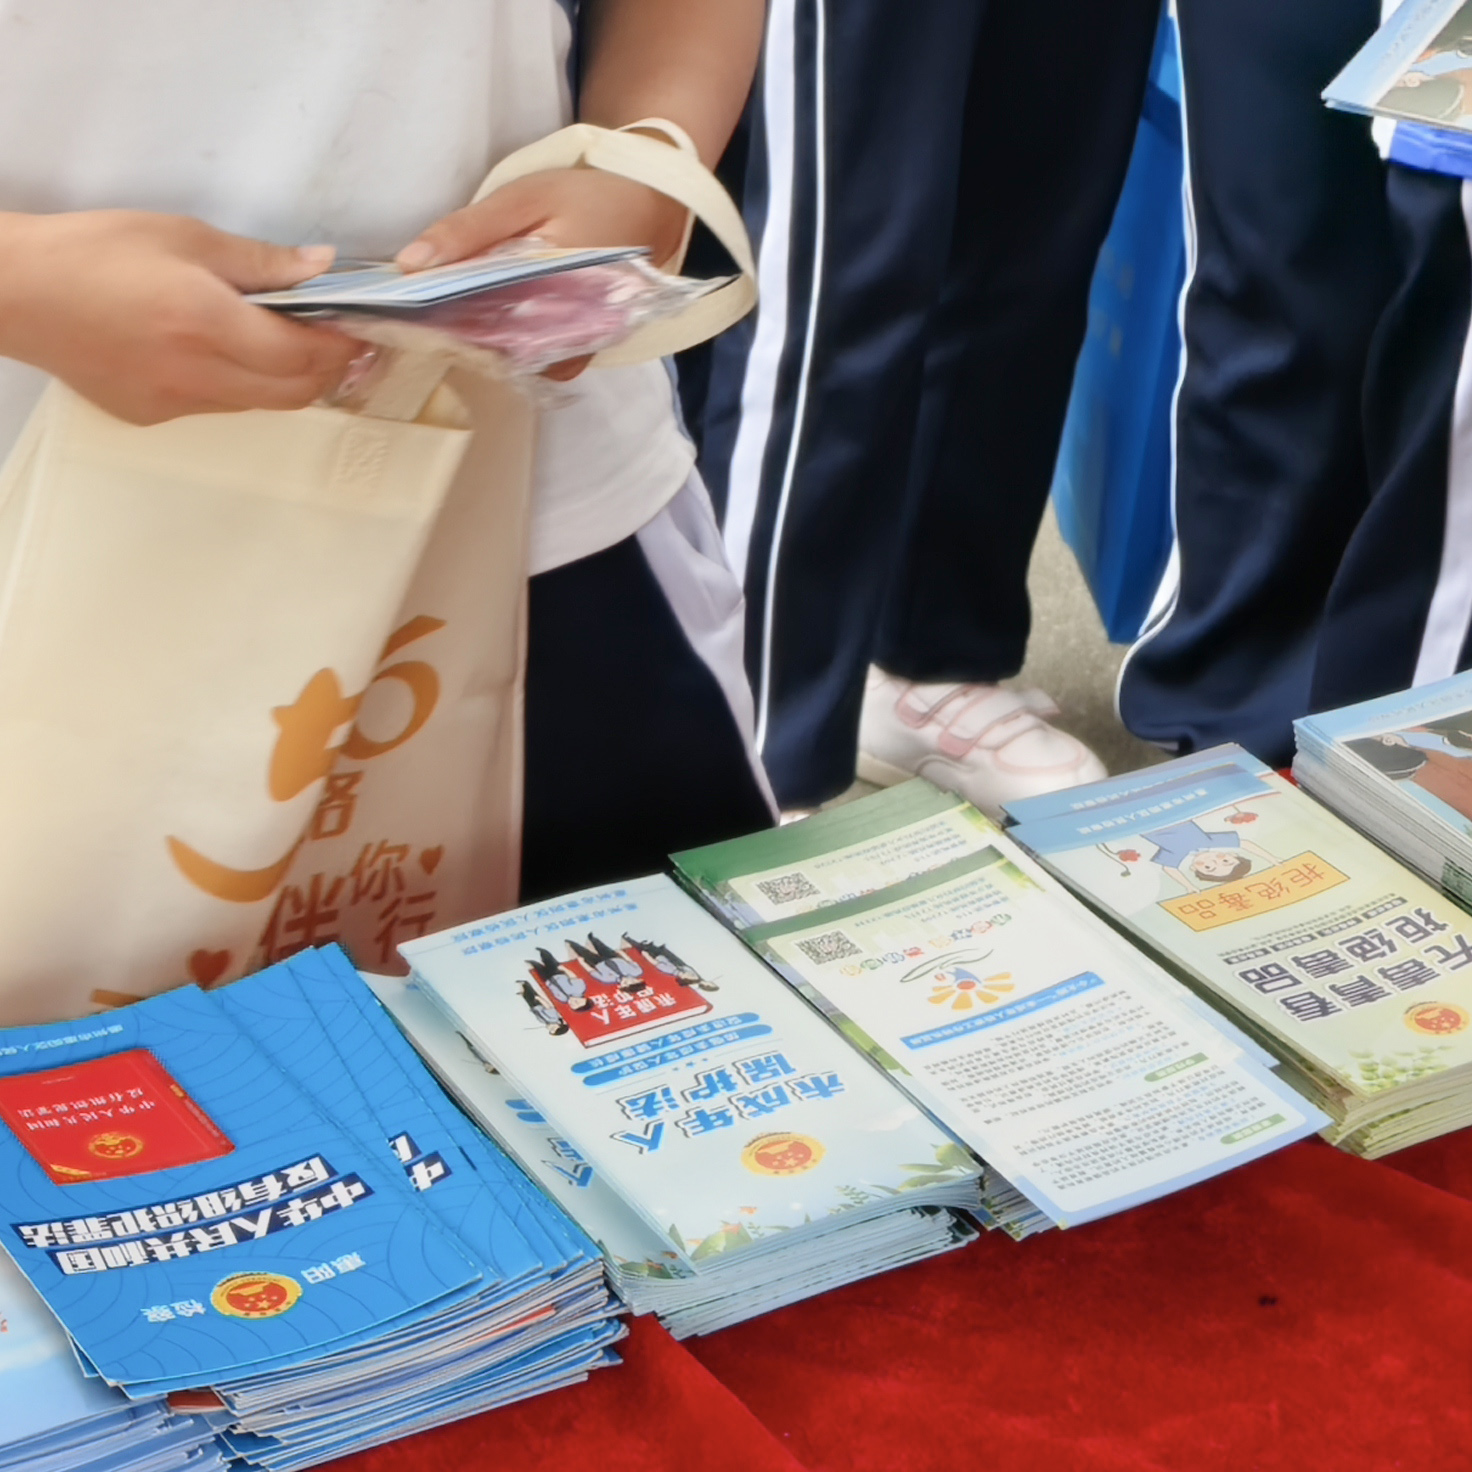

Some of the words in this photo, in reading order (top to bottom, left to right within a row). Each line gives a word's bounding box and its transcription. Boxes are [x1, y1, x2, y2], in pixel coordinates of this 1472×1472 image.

[1238, 906, 1450, 995] 拒绝毒品
[591, 993, 677, 1026] 未成年人
[612, 1070, 847, 1156] 未成年人
[614, 1050, 798, 1120] 保护法
[17, 1154, 334, 1249] 反有组织犯罪法
[53, 1174, 366, 1276] 中华人民共和国
[140, 1299, 207, 1324] 检察
